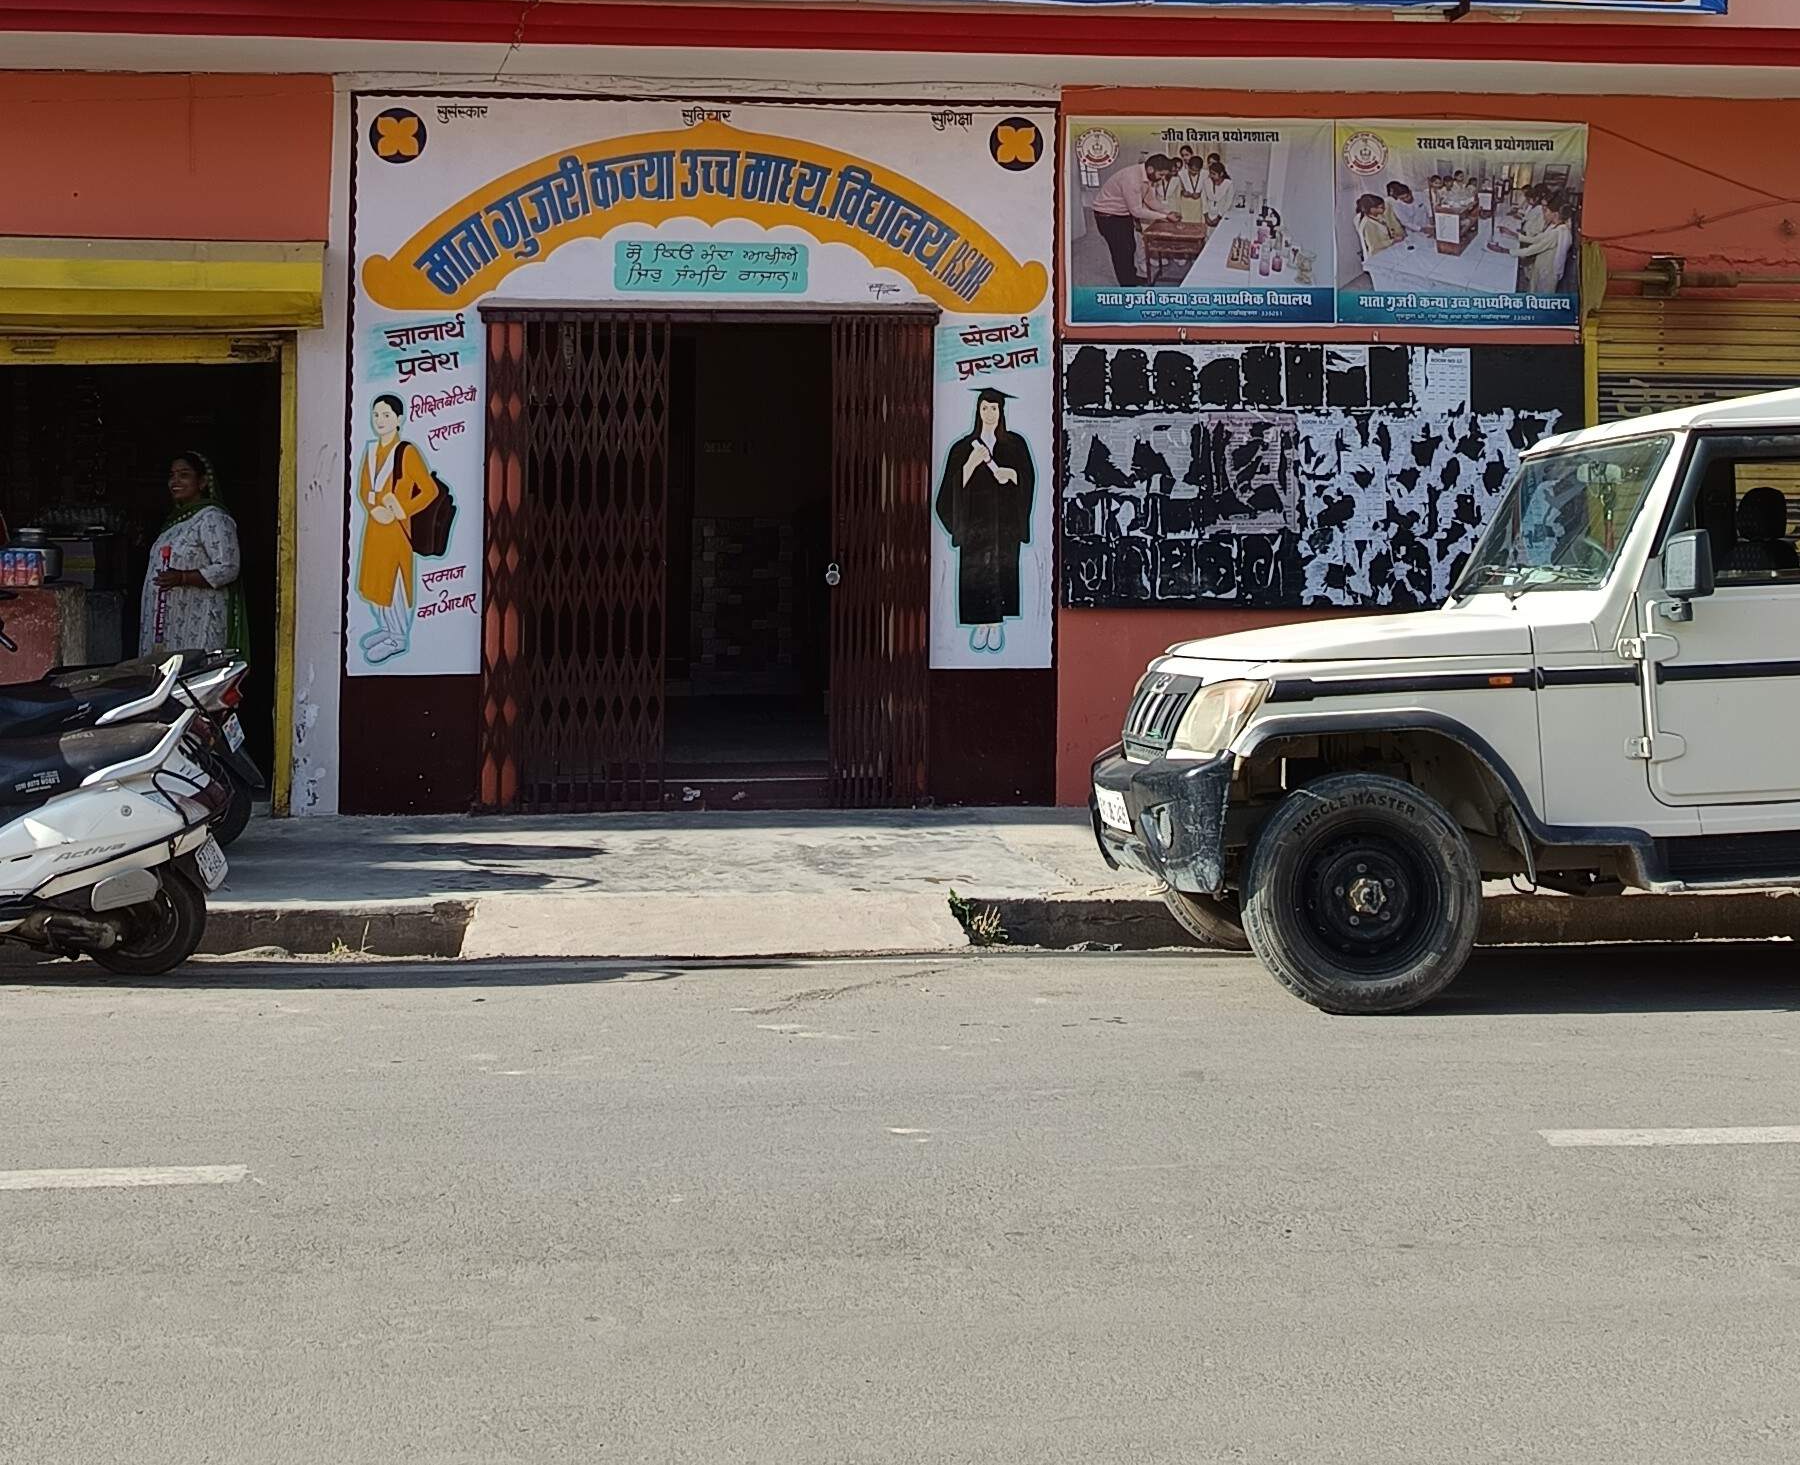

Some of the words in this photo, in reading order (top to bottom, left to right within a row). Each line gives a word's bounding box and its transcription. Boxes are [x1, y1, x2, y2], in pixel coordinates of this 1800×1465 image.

[436, 103, 488, 124] सुसंस्कार
[681, 107, 732, 128] सुविचार
[931, 109, 974, 131] सुशिक्षा
[1161, 128, 1184, 143] जीव
[1186, 127, 1220, 143] विज्ञान
[1222, 127, 1280, 144] प्रयोगशाला
[1457, 134, 1493, 151] विज्ञान
[1495, 136, 1555, 153] प्रयोगशाला
[412, 210, 501, 296] माता
[484, 154, 592, 261] गुजरी
[586, 150, 677, 211] कन्या
[679, 148, 741, 199] उच्च
[1097, 292, 1123, 306] माता
[1125, 290, 1155, 309] गुजरी
[1158, 292, 1188, 306] कन्या
[1213, 290, 1264, 307] माध्यमिक
[1266, 290, 1313, 307] विद्यालय
[384, 312, 467, 351] ज्ञानार्थ
[959, 316, 1030, 349] सेवार्थ
[395, 350, 460, 384] प्रवेश
[955, 345, 1040, 381] प्रस्थान
[421, 564, 467, 592] समाज
[1291, 794, 1348, 837] MUSCLE
[1352, 792, 1417, 819] MASTER
[53, 842, 127, 864] Activa
